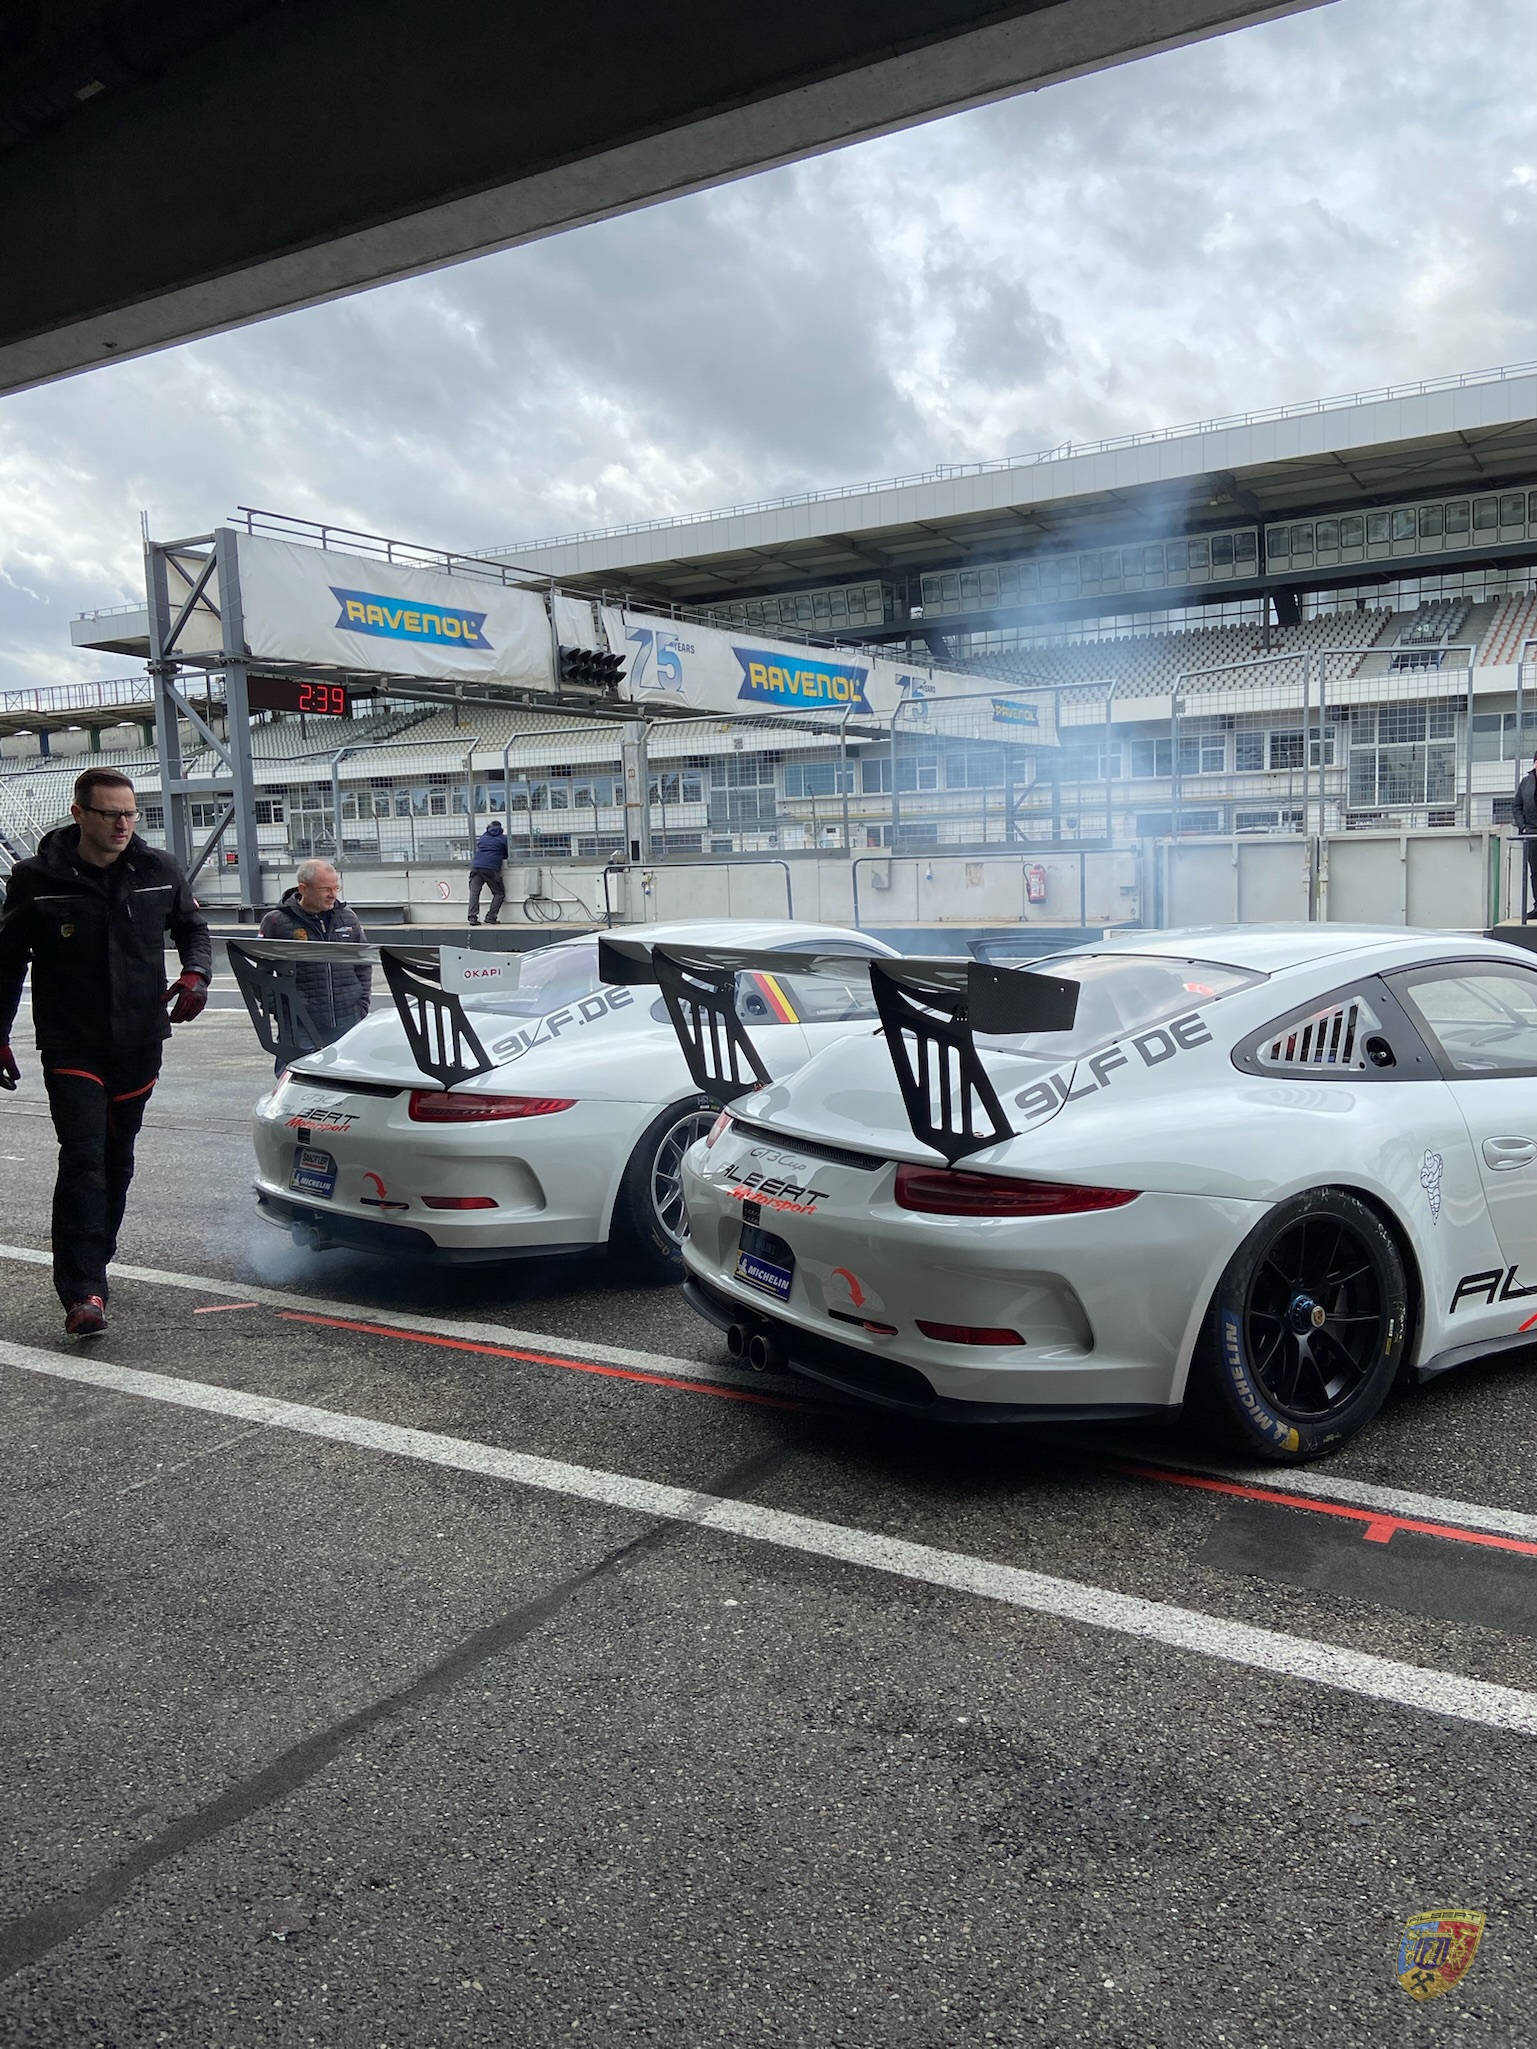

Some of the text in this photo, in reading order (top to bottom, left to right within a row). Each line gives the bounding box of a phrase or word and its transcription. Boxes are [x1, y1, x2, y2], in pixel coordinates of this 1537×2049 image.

[345, 599, 479, 641] RAVENOL
[624, 624, 686, 694] 75
[673, 635, 696, 655] YEARS
[748, 661, 865, 703] RAVENOL
[299, 683, 344, 715] 2:39
[462, 967, 502, 979] OKAPI
[491, 986, 635, 1061] 9LF.DE
[1014, 1012, 1214, 1121] 9LF DE
[285, 1116, 352, 1132] Motorsport
[300, 1177, 332, 1191] MICHELIN
[726, 1184, 818, 1215] Motorsport
[747, 1265, 790, 1290] MICHELIN
[1224, 1321, 1273, 1436] MICHELIN
